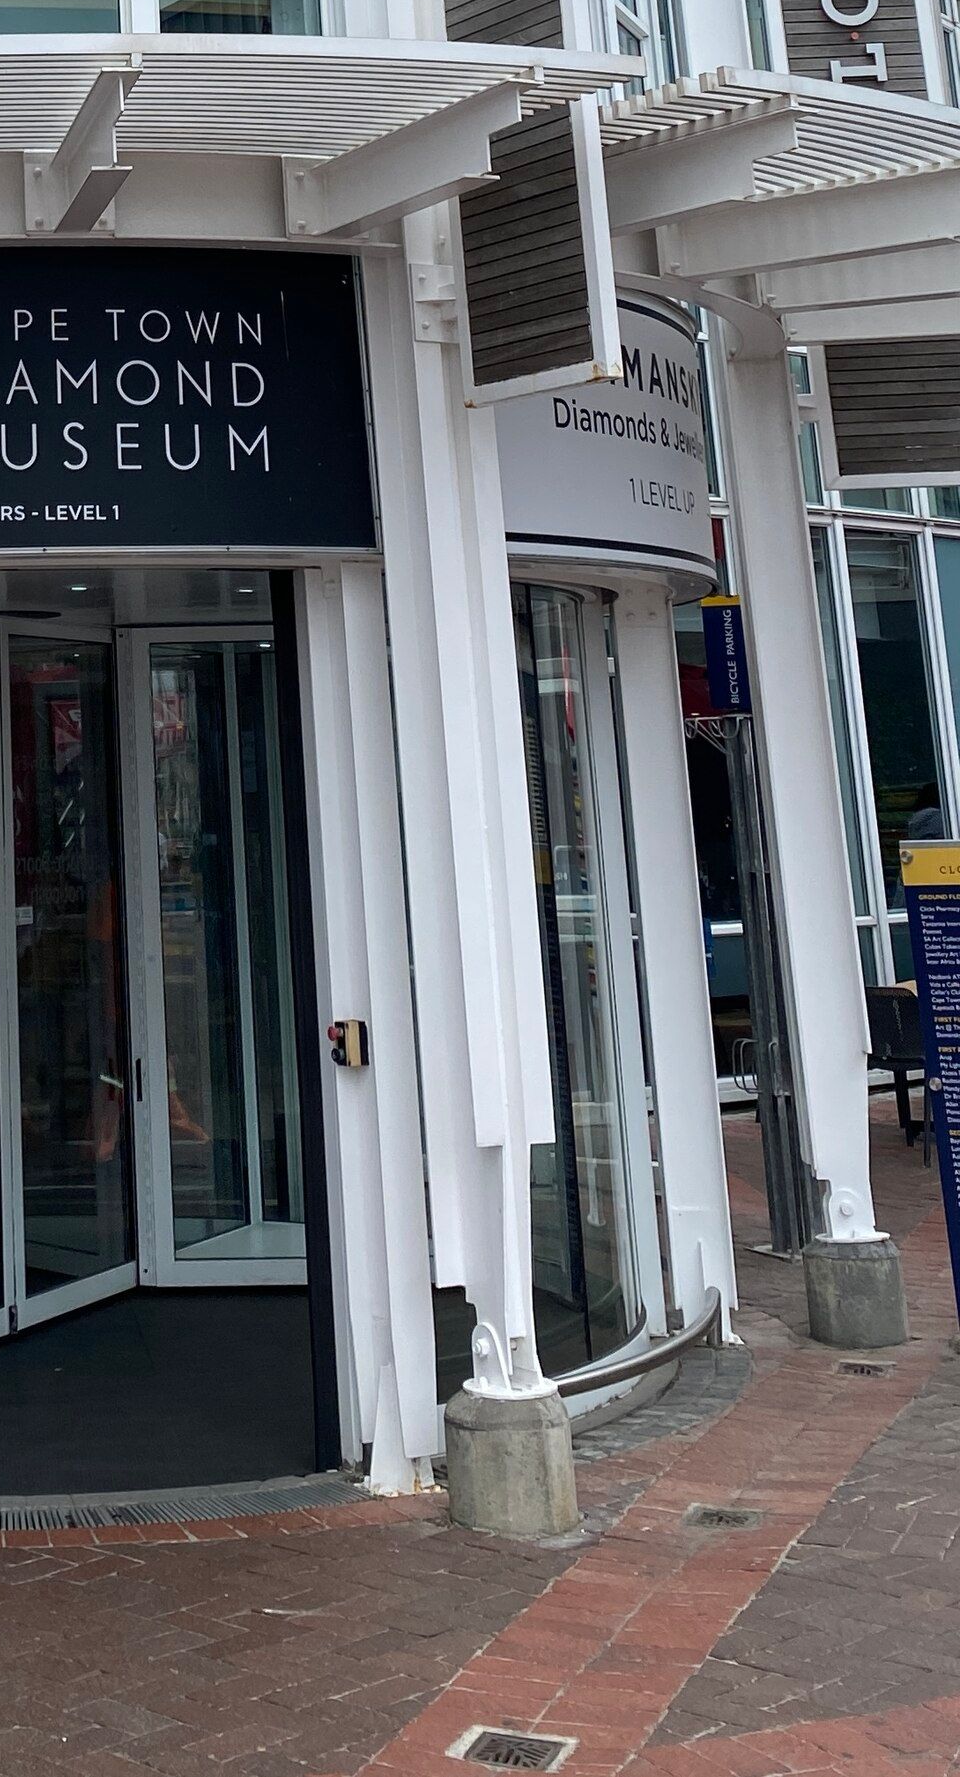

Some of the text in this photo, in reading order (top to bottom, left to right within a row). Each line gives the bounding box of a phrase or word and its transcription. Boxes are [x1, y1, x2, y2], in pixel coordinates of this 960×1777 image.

[104, 308, 262, 346] TOWN
[552, 396, 657, 445] Diamonds
[660, 417, 671, 448] &
[44, 504, 107, 521] LEVEL
[112, 504, 120, 521] 1
[629, 477, 696, 515] 1 LEVEL UP
[722, 608, 740, 704] BICYCLE PARKING
